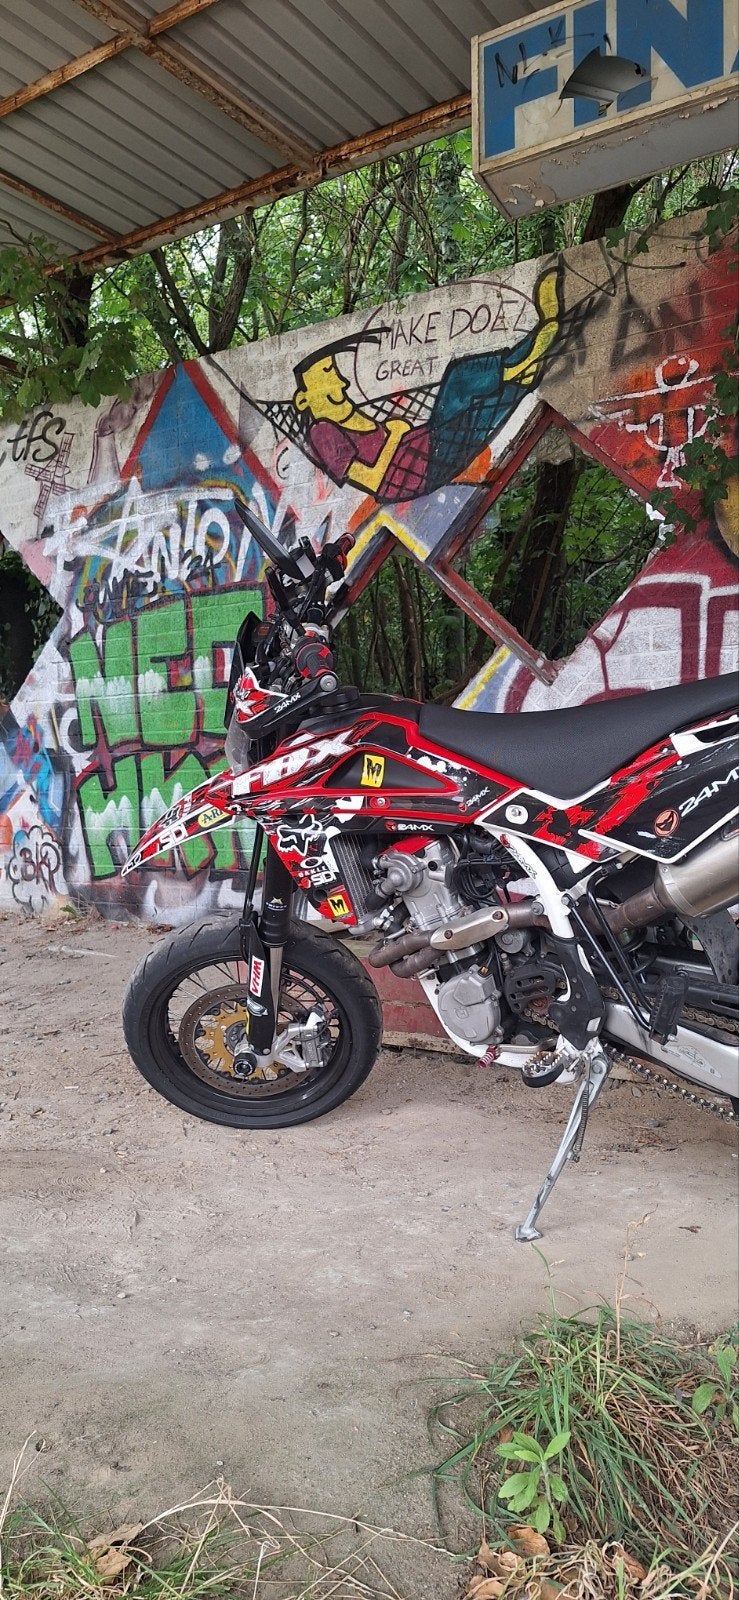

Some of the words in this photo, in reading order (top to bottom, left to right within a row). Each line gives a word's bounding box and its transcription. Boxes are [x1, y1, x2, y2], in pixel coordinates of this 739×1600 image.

[483, 0, 739, 158] FIN
[379, 311, 441, 351] MAKE
[449, 299, 532, 339] DOEL
[375, 356, 441, 382] GREAT
